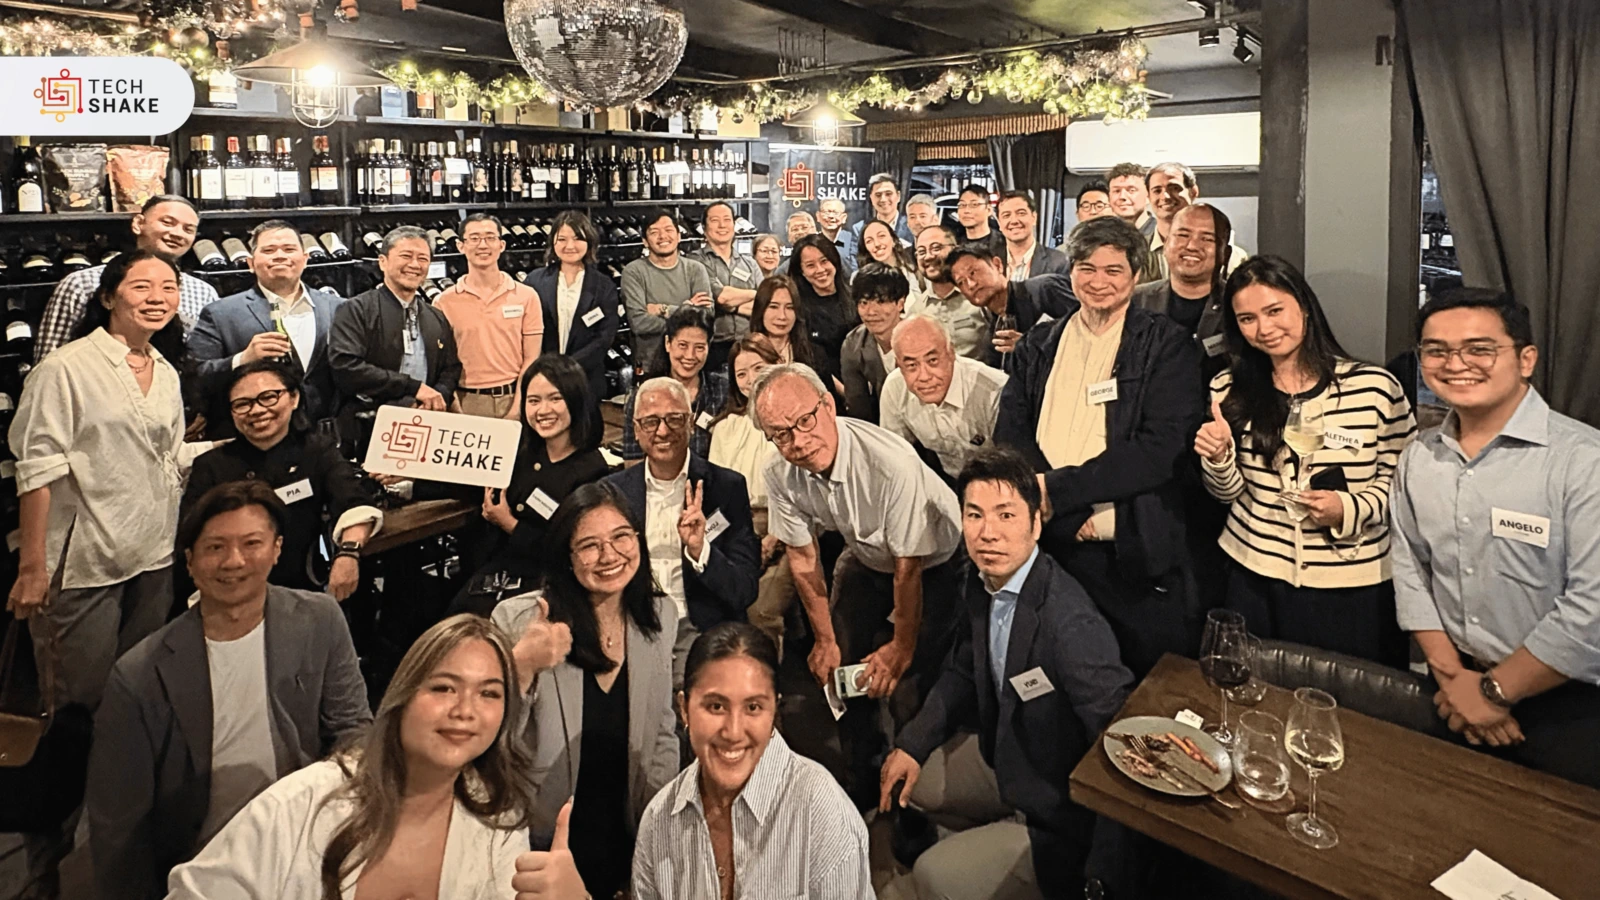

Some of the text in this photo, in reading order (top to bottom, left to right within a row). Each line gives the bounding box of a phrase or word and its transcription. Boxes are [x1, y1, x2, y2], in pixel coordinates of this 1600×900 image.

[817, 171, 856, 185] TECH
[817, 187, 867, 201] SHAKE
[1090, 386, 1114, 397] GEORGE
[438, 428, 491, 450] TECH
[1324, 431, 1359, 445] ALETHEA
[432, 448, 503, 472] SHAKE
[286, 488, 301, 498] PIA
[1499, 518, 1544, 535] ANGELO
